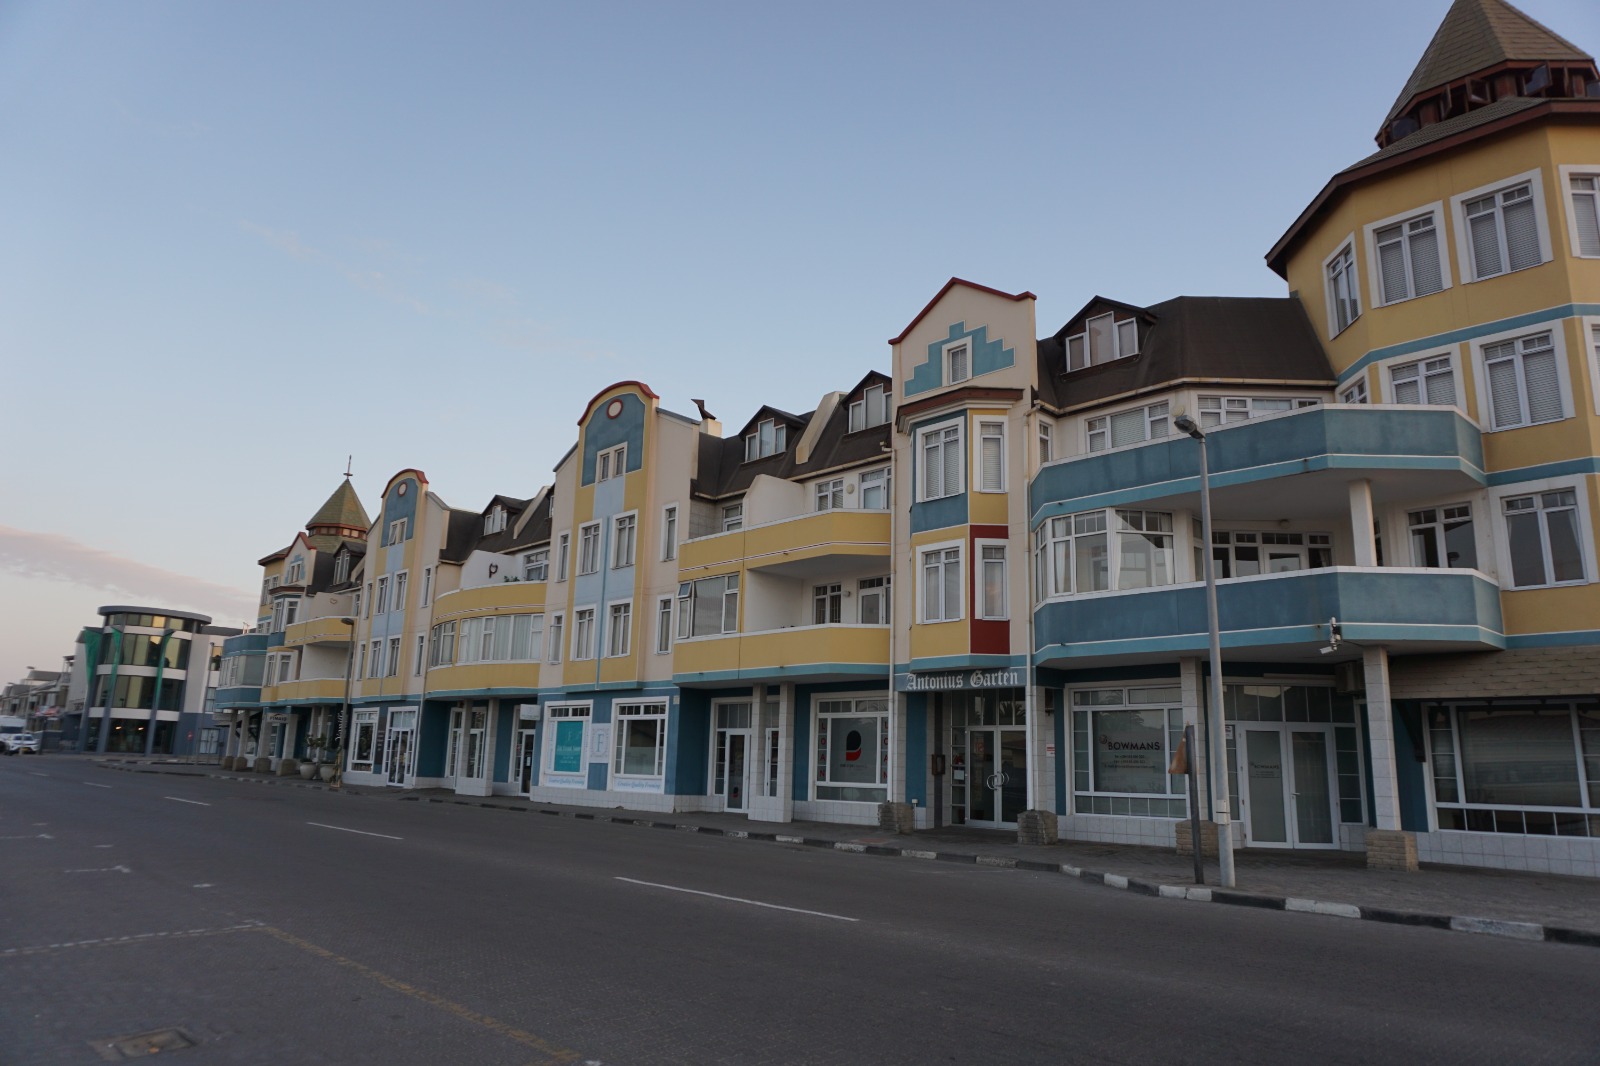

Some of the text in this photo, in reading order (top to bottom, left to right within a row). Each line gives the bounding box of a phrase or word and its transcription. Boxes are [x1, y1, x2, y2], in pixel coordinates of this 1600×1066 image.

[906, 669, 1018, 690] Antonius Garten
[595, 733, 605, 752] F
[1107, 741, 1160, 750] BOWMANS
